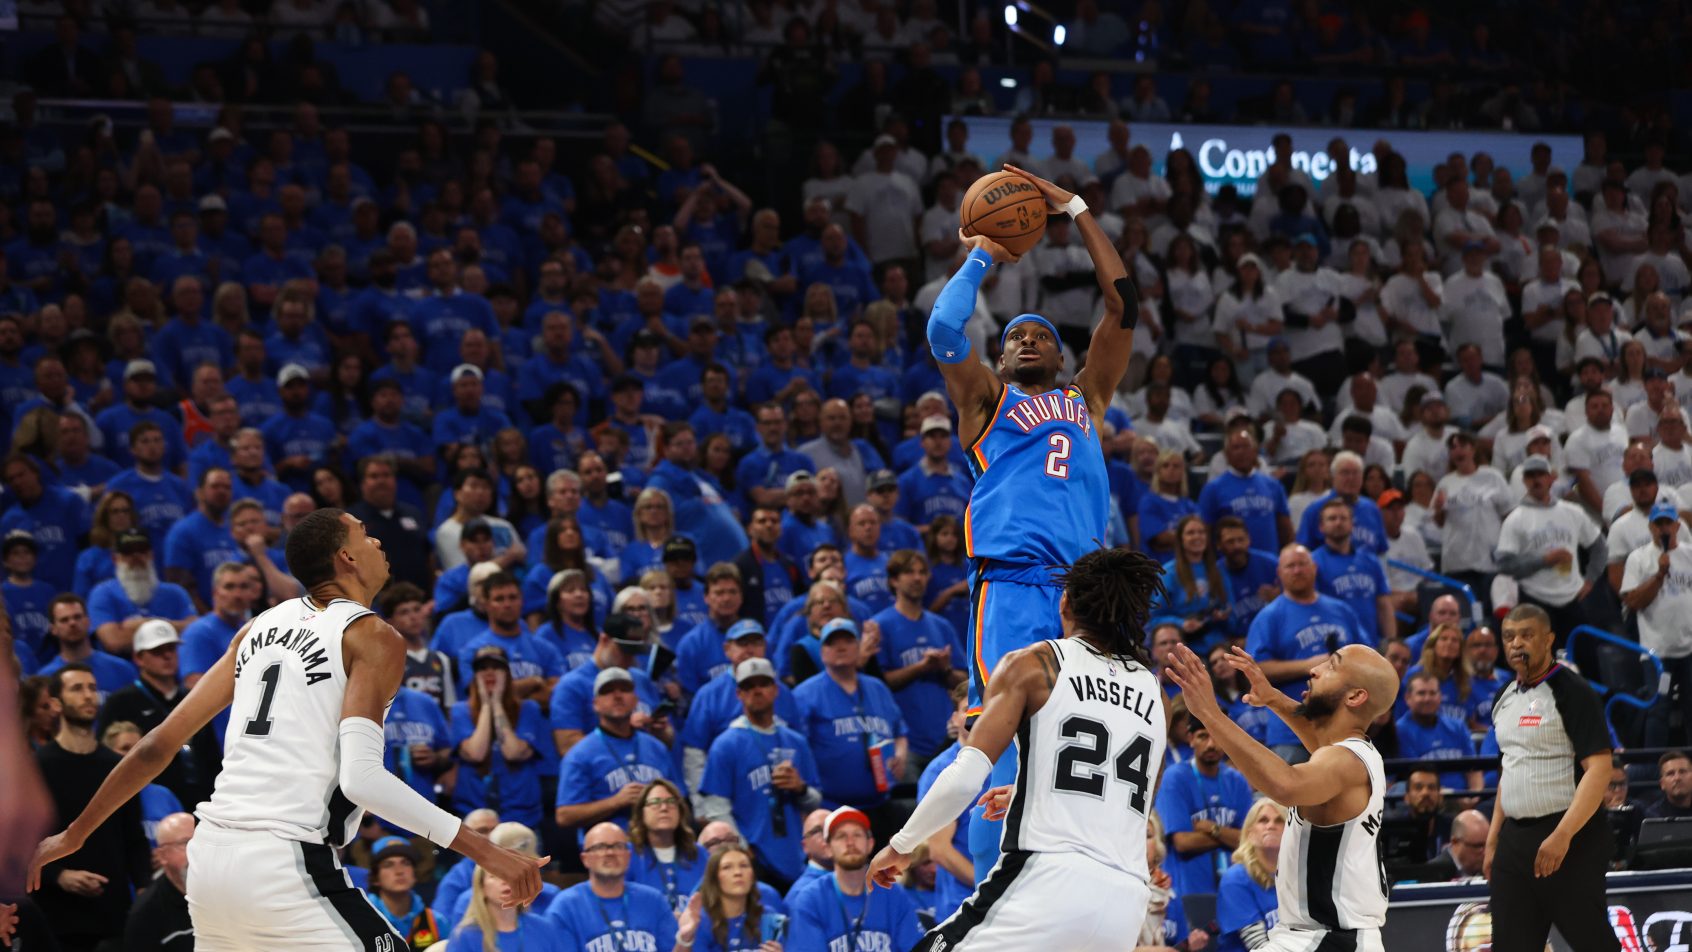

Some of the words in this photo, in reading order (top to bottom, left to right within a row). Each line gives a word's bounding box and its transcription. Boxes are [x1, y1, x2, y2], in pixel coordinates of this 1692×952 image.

[983, 181, 1036, 205] Wilson
[1006, 394, 1091, 440] THUNDER
[1045, 433, 1072, 480] 2
[235, 627, 332, 686] WEMBANYAMA
[241, 660, 282, 739] 1
[1069, 675, 1154, 725] VASSELL
[1051, 713, 1154, 819] 24
